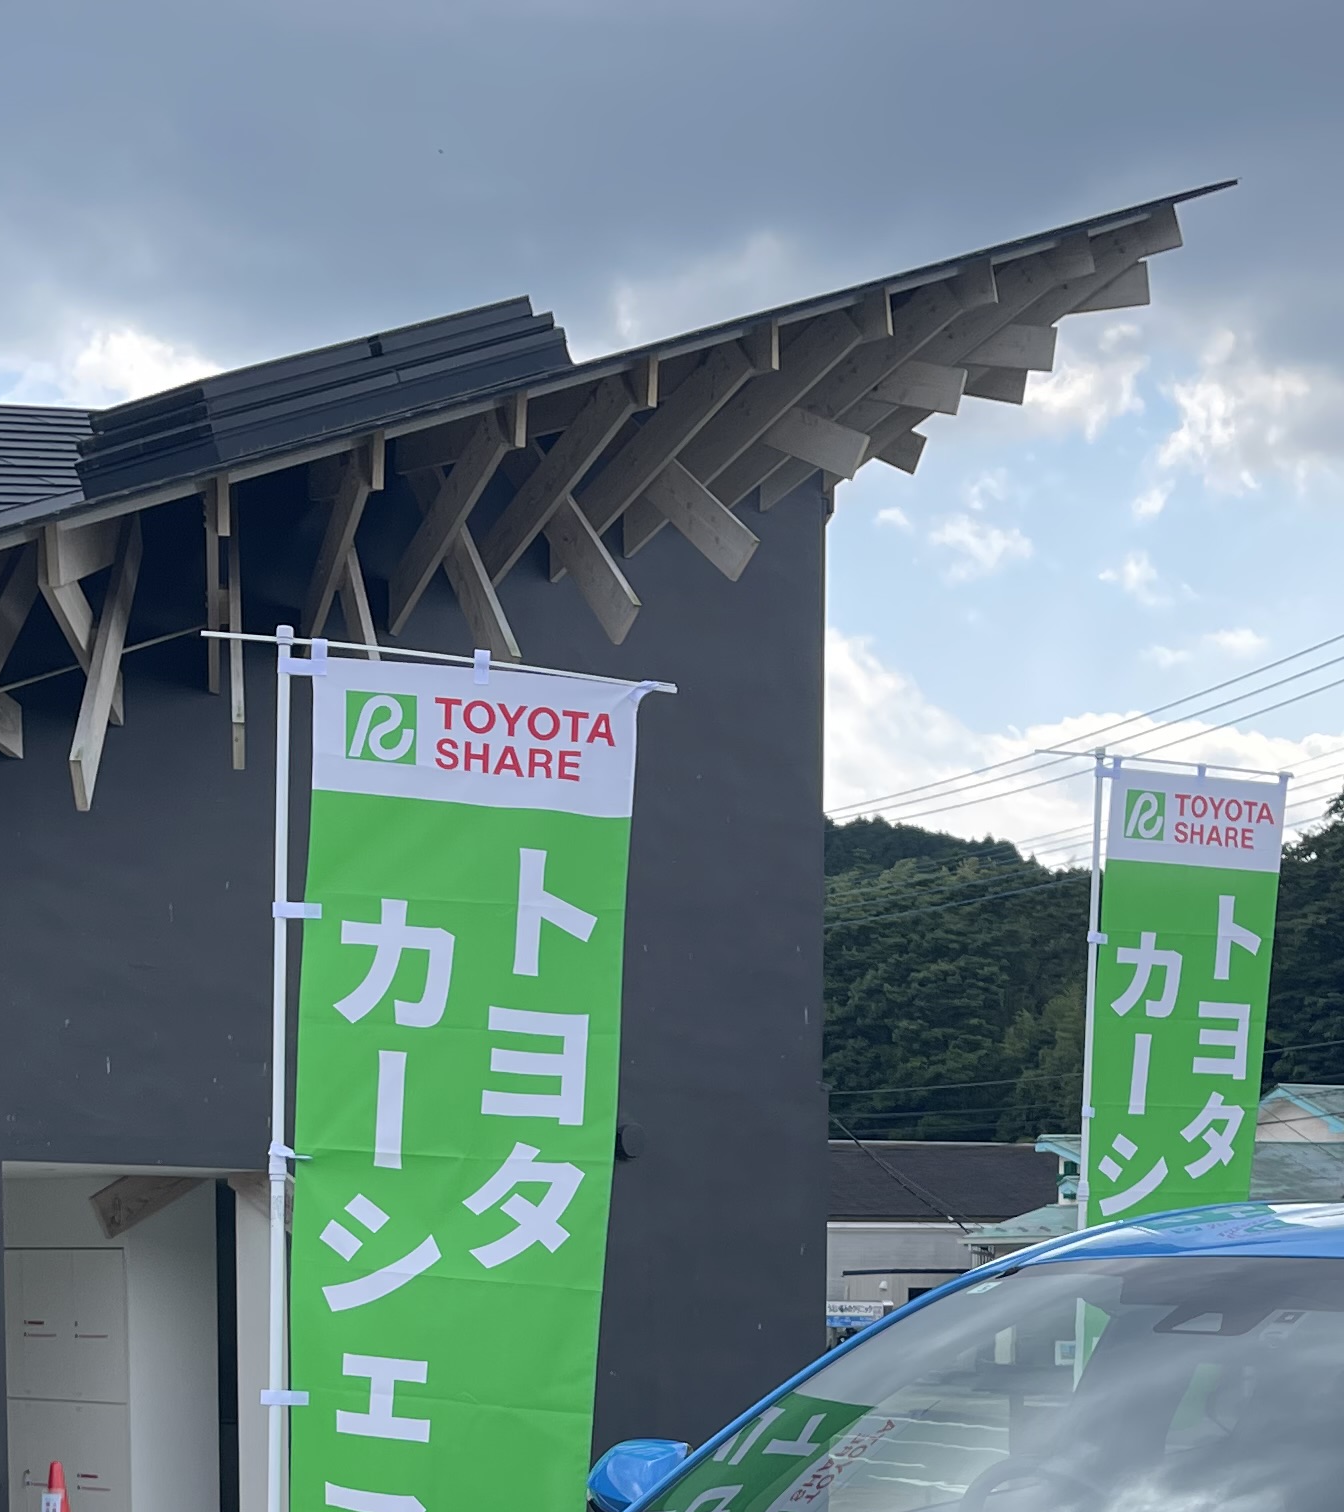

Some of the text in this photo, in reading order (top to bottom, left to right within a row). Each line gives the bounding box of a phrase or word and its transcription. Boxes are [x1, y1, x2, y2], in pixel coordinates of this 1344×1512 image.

[434, 696, 616, 748] TOYOTA
[435, 737, 582, 782] SHARE
[1175, 793, 1274, 825] TOYOTA
[1174, 822, 1254, 850] SHARE
[461, 847, 599, 1269] トヨタ
[1179, 894, 1263, 1180] トヨタ
